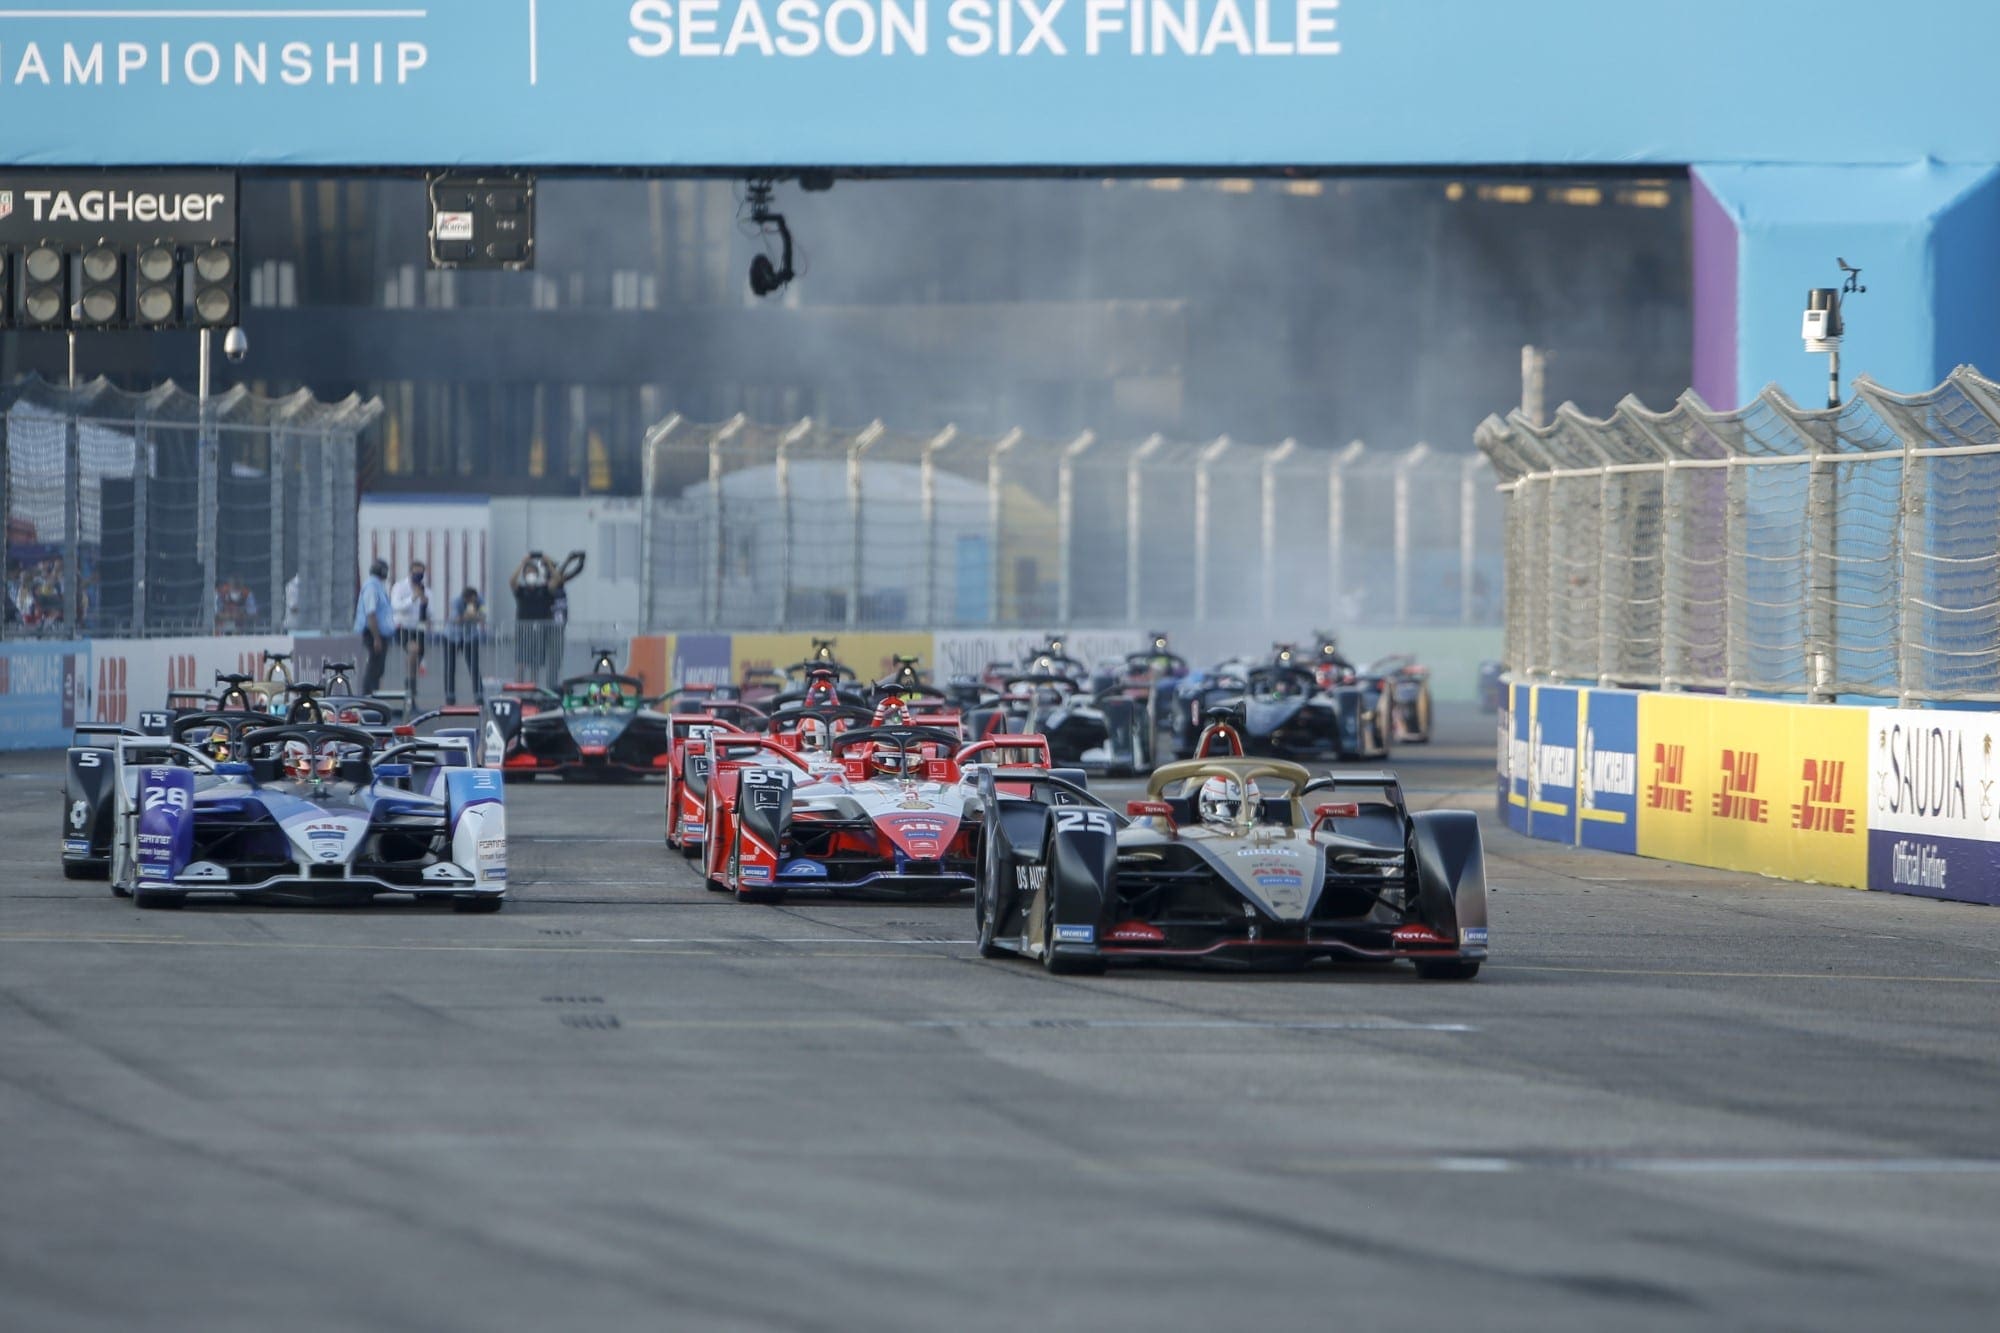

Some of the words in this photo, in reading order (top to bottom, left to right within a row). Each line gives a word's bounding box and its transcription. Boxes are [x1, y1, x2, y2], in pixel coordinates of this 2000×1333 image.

[627, 0, 928, 57] SEASON
[946, 0, 1068, 57] SIX
[1085, 0, 1342, 57] FINALE
[0, 42, 427, 85] AMPIONSHIP
[493, 702, 512, 716] 11
[141, 713, 167, 728] 13
[78, 753, 100, 767] 5
[743, 769, 789, 789] 64
[1890, 723, 1967, 820] SAUDIA
[1057, 811, 1112, 836] 25
[1892, 840, 1921, 886] Official
[1920, 843, 1947, 890] Airline
[1016, 865, 1028, 890] DS
[1113, 930, 1156, 939] TOTAL
[1394, 932, 1439, 940] TOTAL
